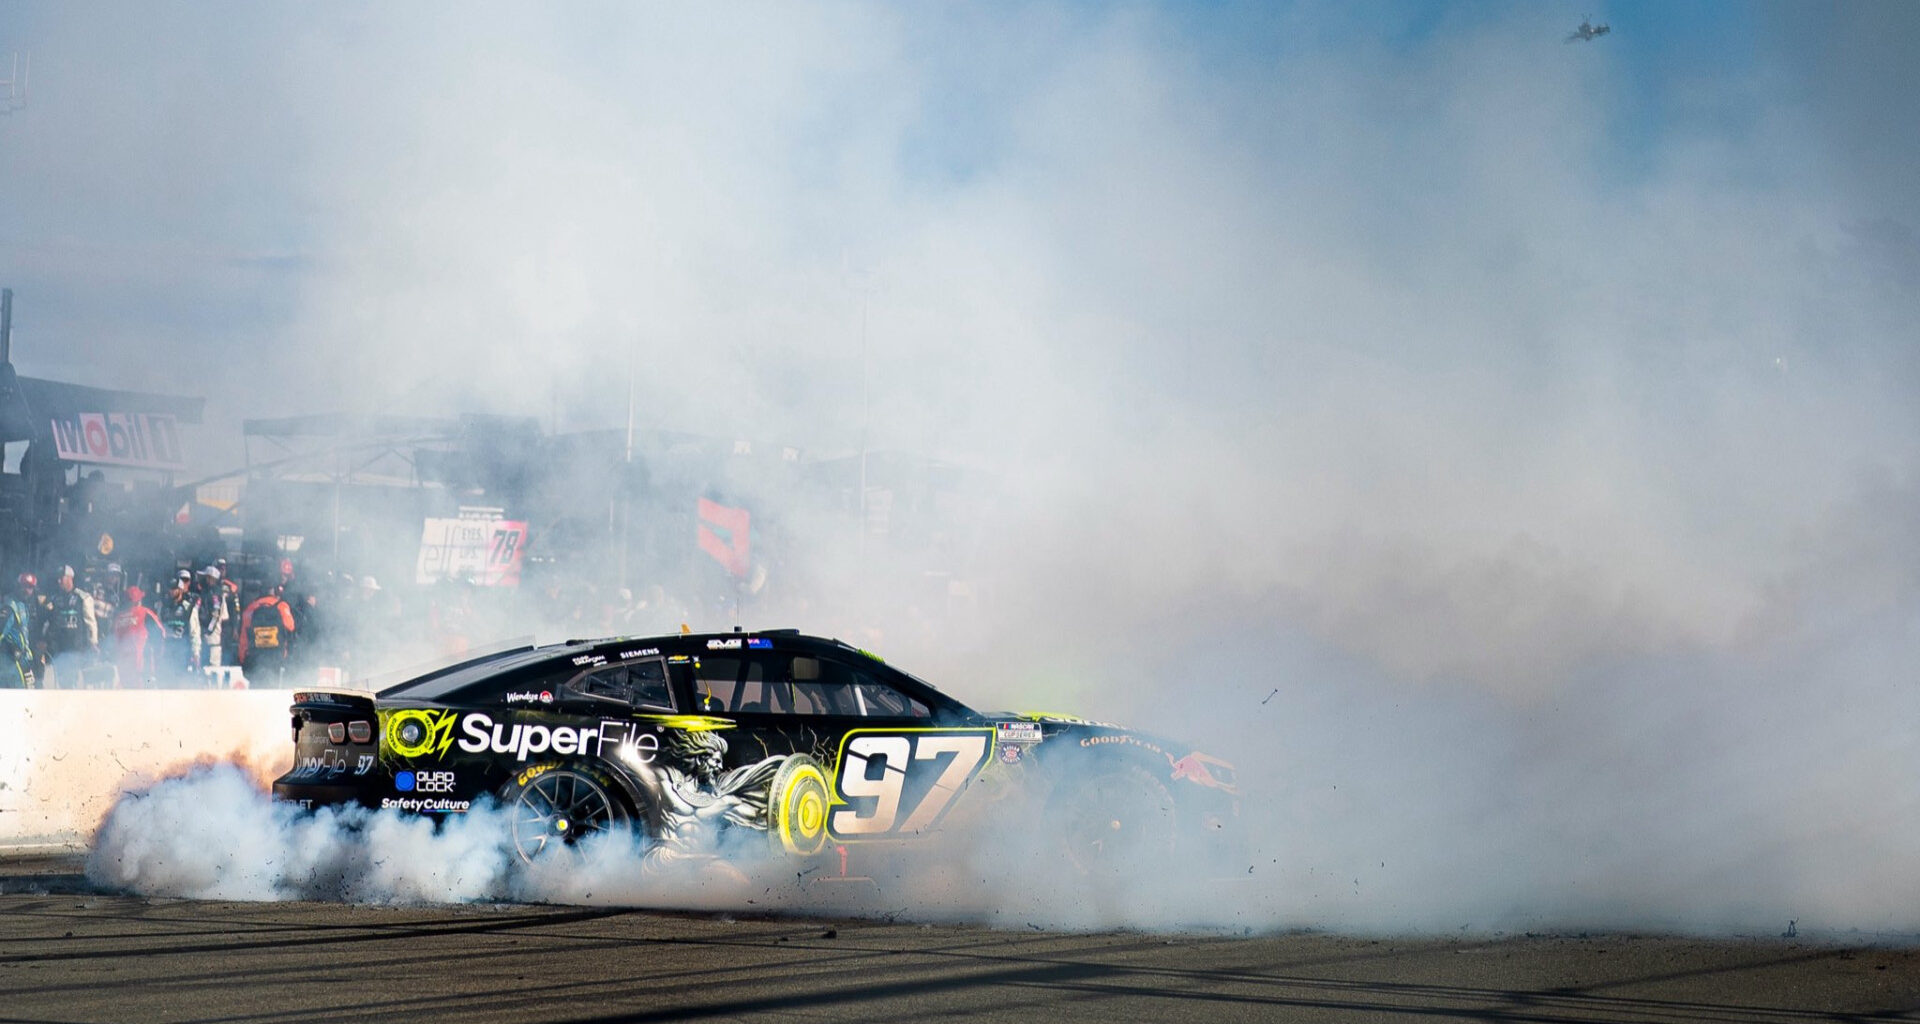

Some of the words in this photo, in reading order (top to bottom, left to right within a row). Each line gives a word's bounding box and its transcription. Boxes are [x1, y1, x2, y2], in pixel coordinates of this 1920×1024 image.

[489, 529, 521, 564] 78
[620, 647, 660, 659] SIEMENS
[458, 713, 660, 763] SuperFile
[416, 771, 455, 782] QUAD
[416, 781, 454, 793] LOCK
[833, 736, 987, 834] 97
[381, 798, 470, 812] SafetyCulture
